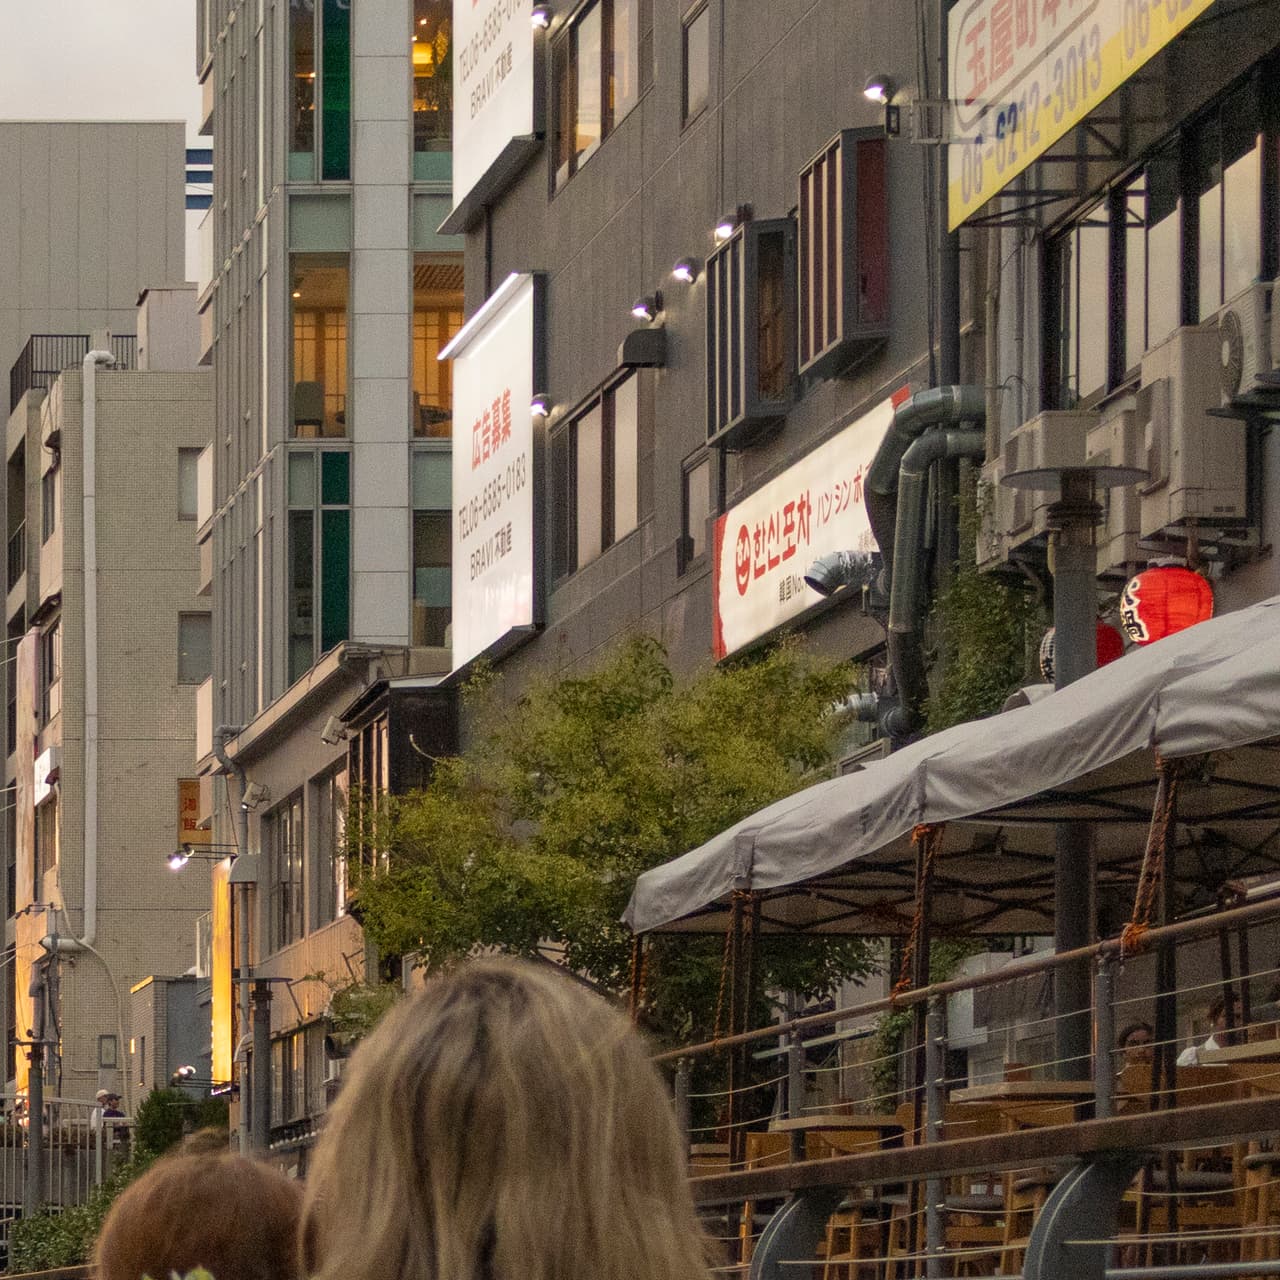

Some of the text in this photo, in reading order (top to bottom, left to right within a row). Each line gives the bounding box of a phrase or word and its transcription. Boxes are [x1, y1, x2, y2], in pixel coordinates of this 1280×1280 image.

[459, 0, 526, 86] TEL06-6585-0
[961, 23, 1102, 205] 06-6212-3013
[471, 387, 512, 472] 広告募集
[470, 536, 494, 582] BRAVI
[752, 489, 813, 580] 한신포차
